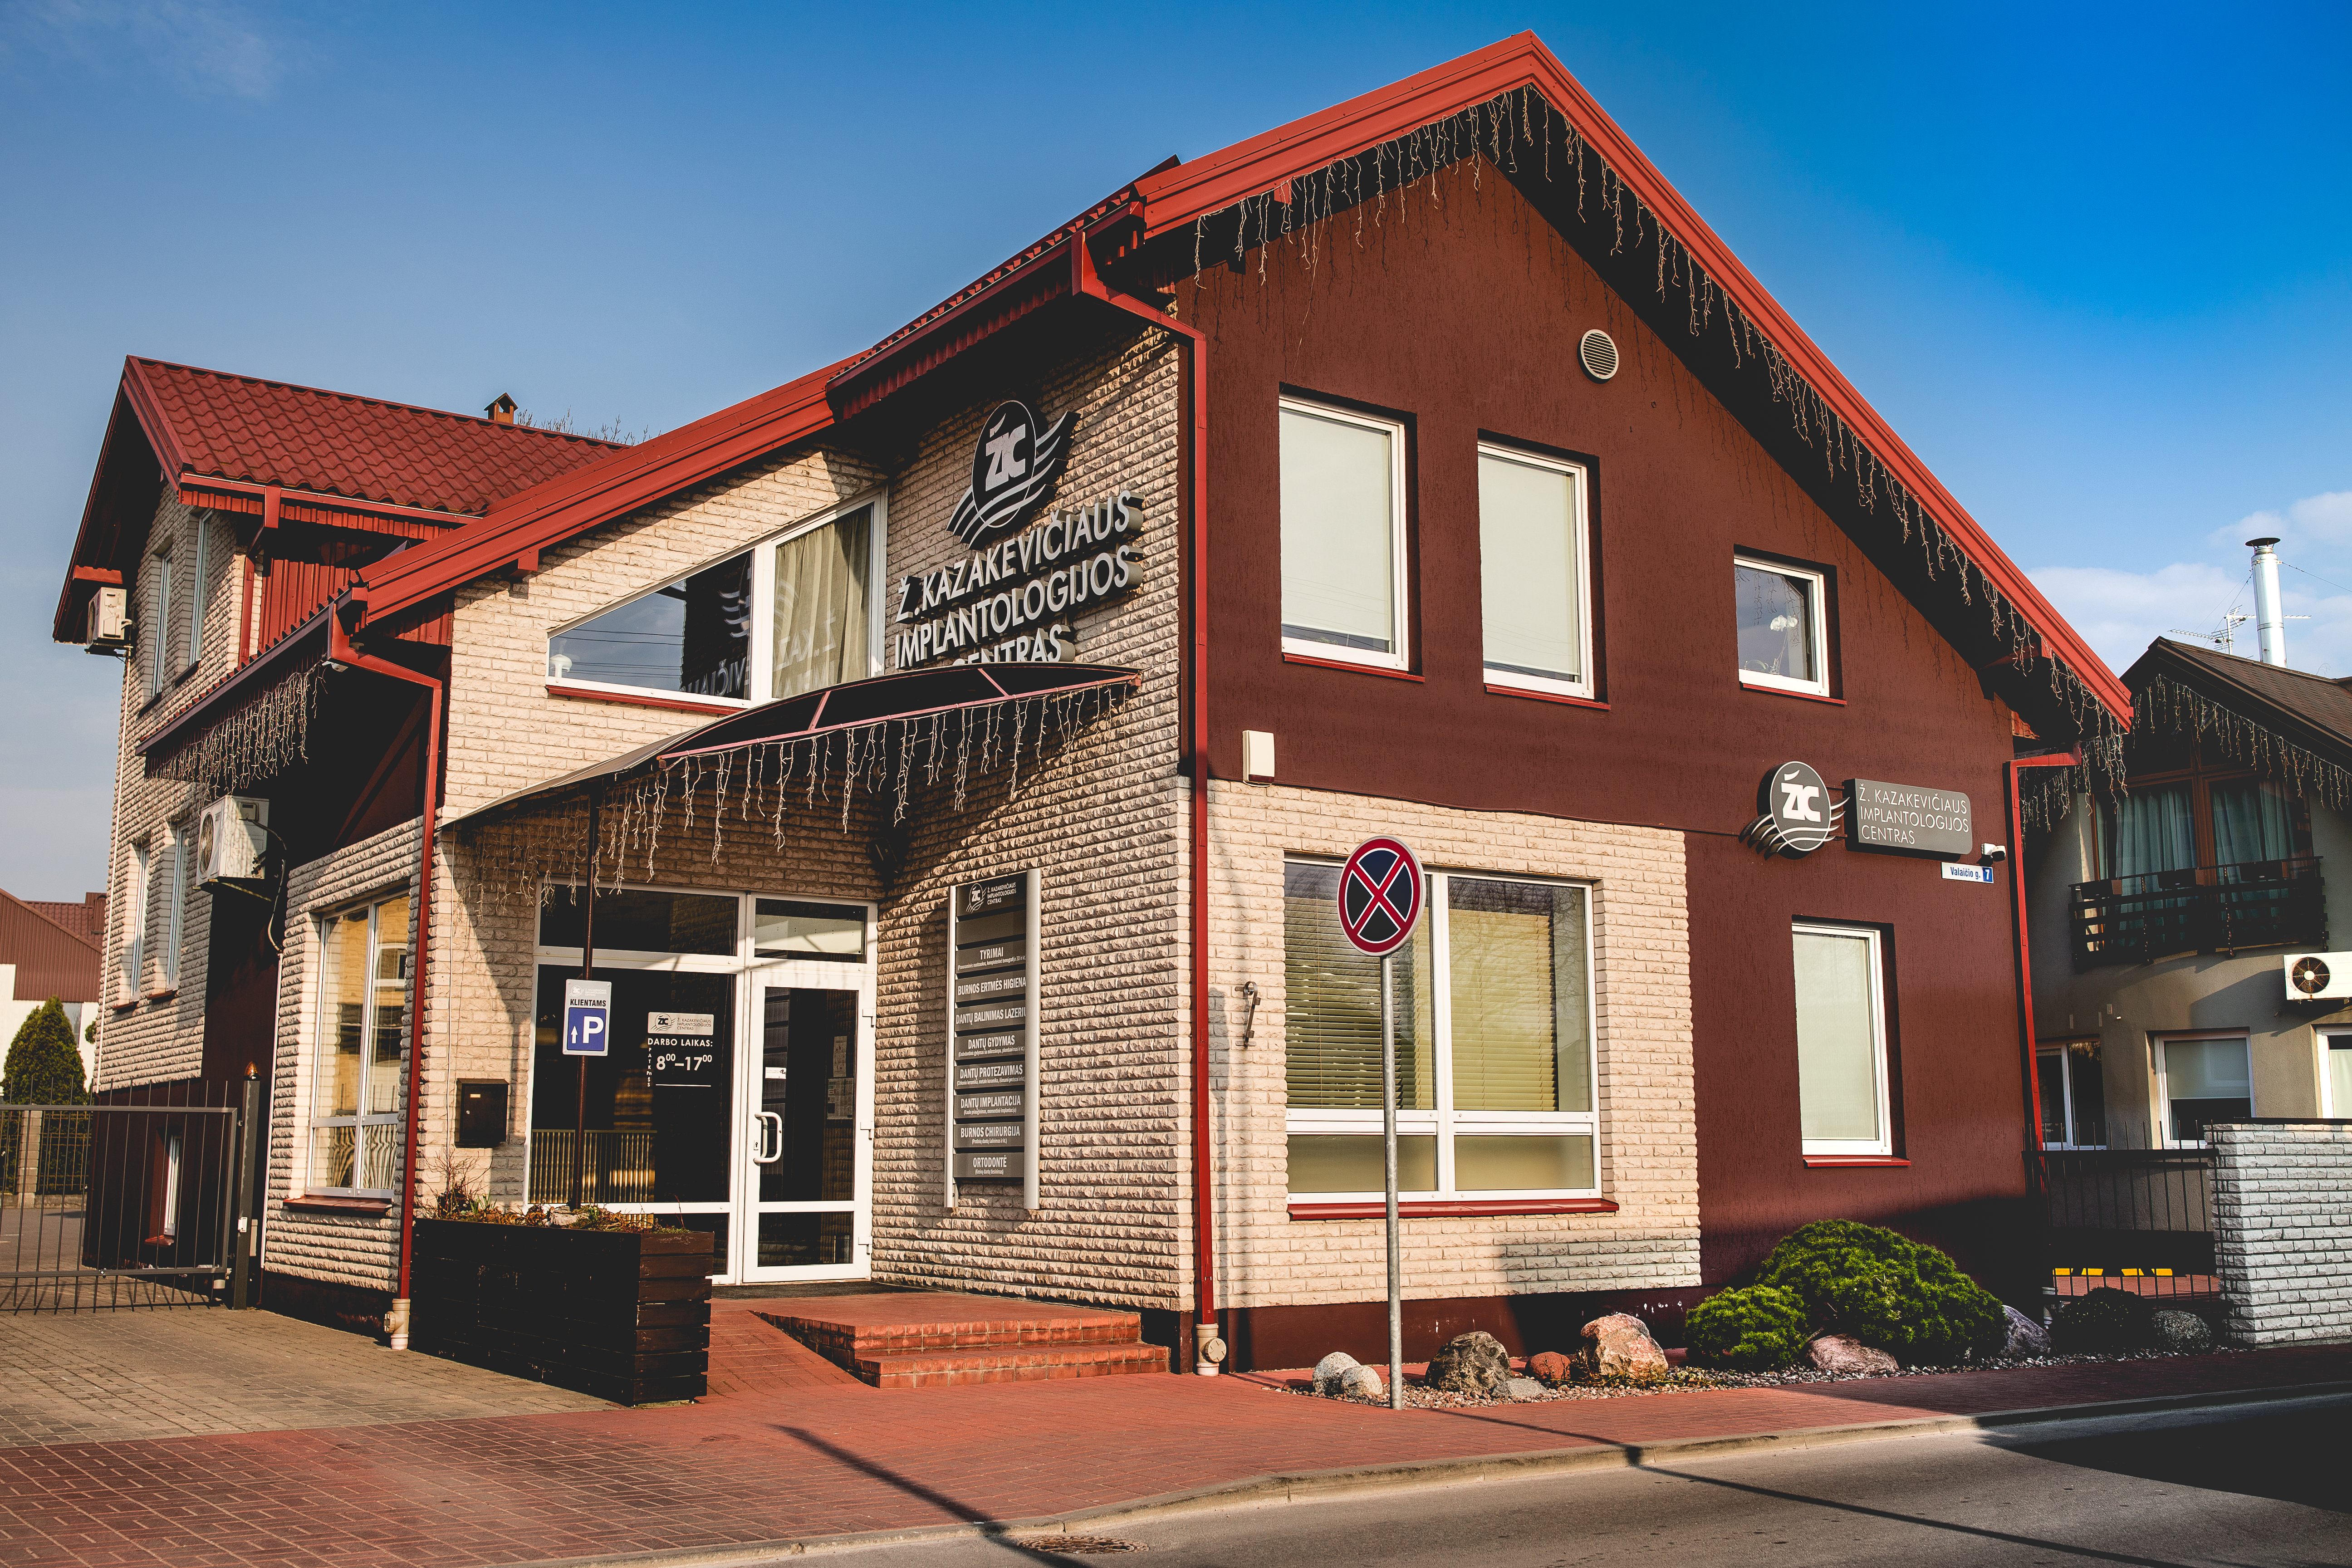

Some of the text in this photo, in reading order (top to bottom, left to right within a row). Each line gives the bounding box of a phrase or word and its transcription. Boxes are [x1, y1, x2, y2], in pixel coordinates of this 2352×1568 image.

[895, 545, 1130, 669] IMPLANTOLOGIJOS
[952, 625, 1062, 665] TRAS
[1859, 783, 1967, 814] Ž. KAZAKEVIČIAUS
[1860, 806, 1969, 833] IMPLANTOLOGIJOS
[1862, 825, 1915, 844] CENTRAS
[1950, 867, 1990, 880] Valaičio g. 7
[987, 888, 1016, 899] IMPLANTOLOGIJOS
[991, 882, 1016, 892] KAZAKEVIČIAUS
[980, 946, 1004, 960] TYRIMAI
[958, 977, 1026, 995] BURNOS ERTMĖS HIGIENA
[570, 999, 606, 1007] KLIENTAMS
[956, 1013, 973, 1025] DANTŲ
[974, 1009, 1004, 1022] BALINIMAS
[583, 1016, 604, 1044] P
[968, 1034, 1015, 1050] DANTŲ GYDYMAS
[960, 1064, 1023, 1080] DANTŲ PROTEZAVIMAS
[961, 1095, 1021, 1109] DANTŲ IMPLANTACIJA
[961, 1126, 1020, 1137] BURNOS CHIRURGIJA
[973, 1154, 1007, 1168] ORTODONTĖ
